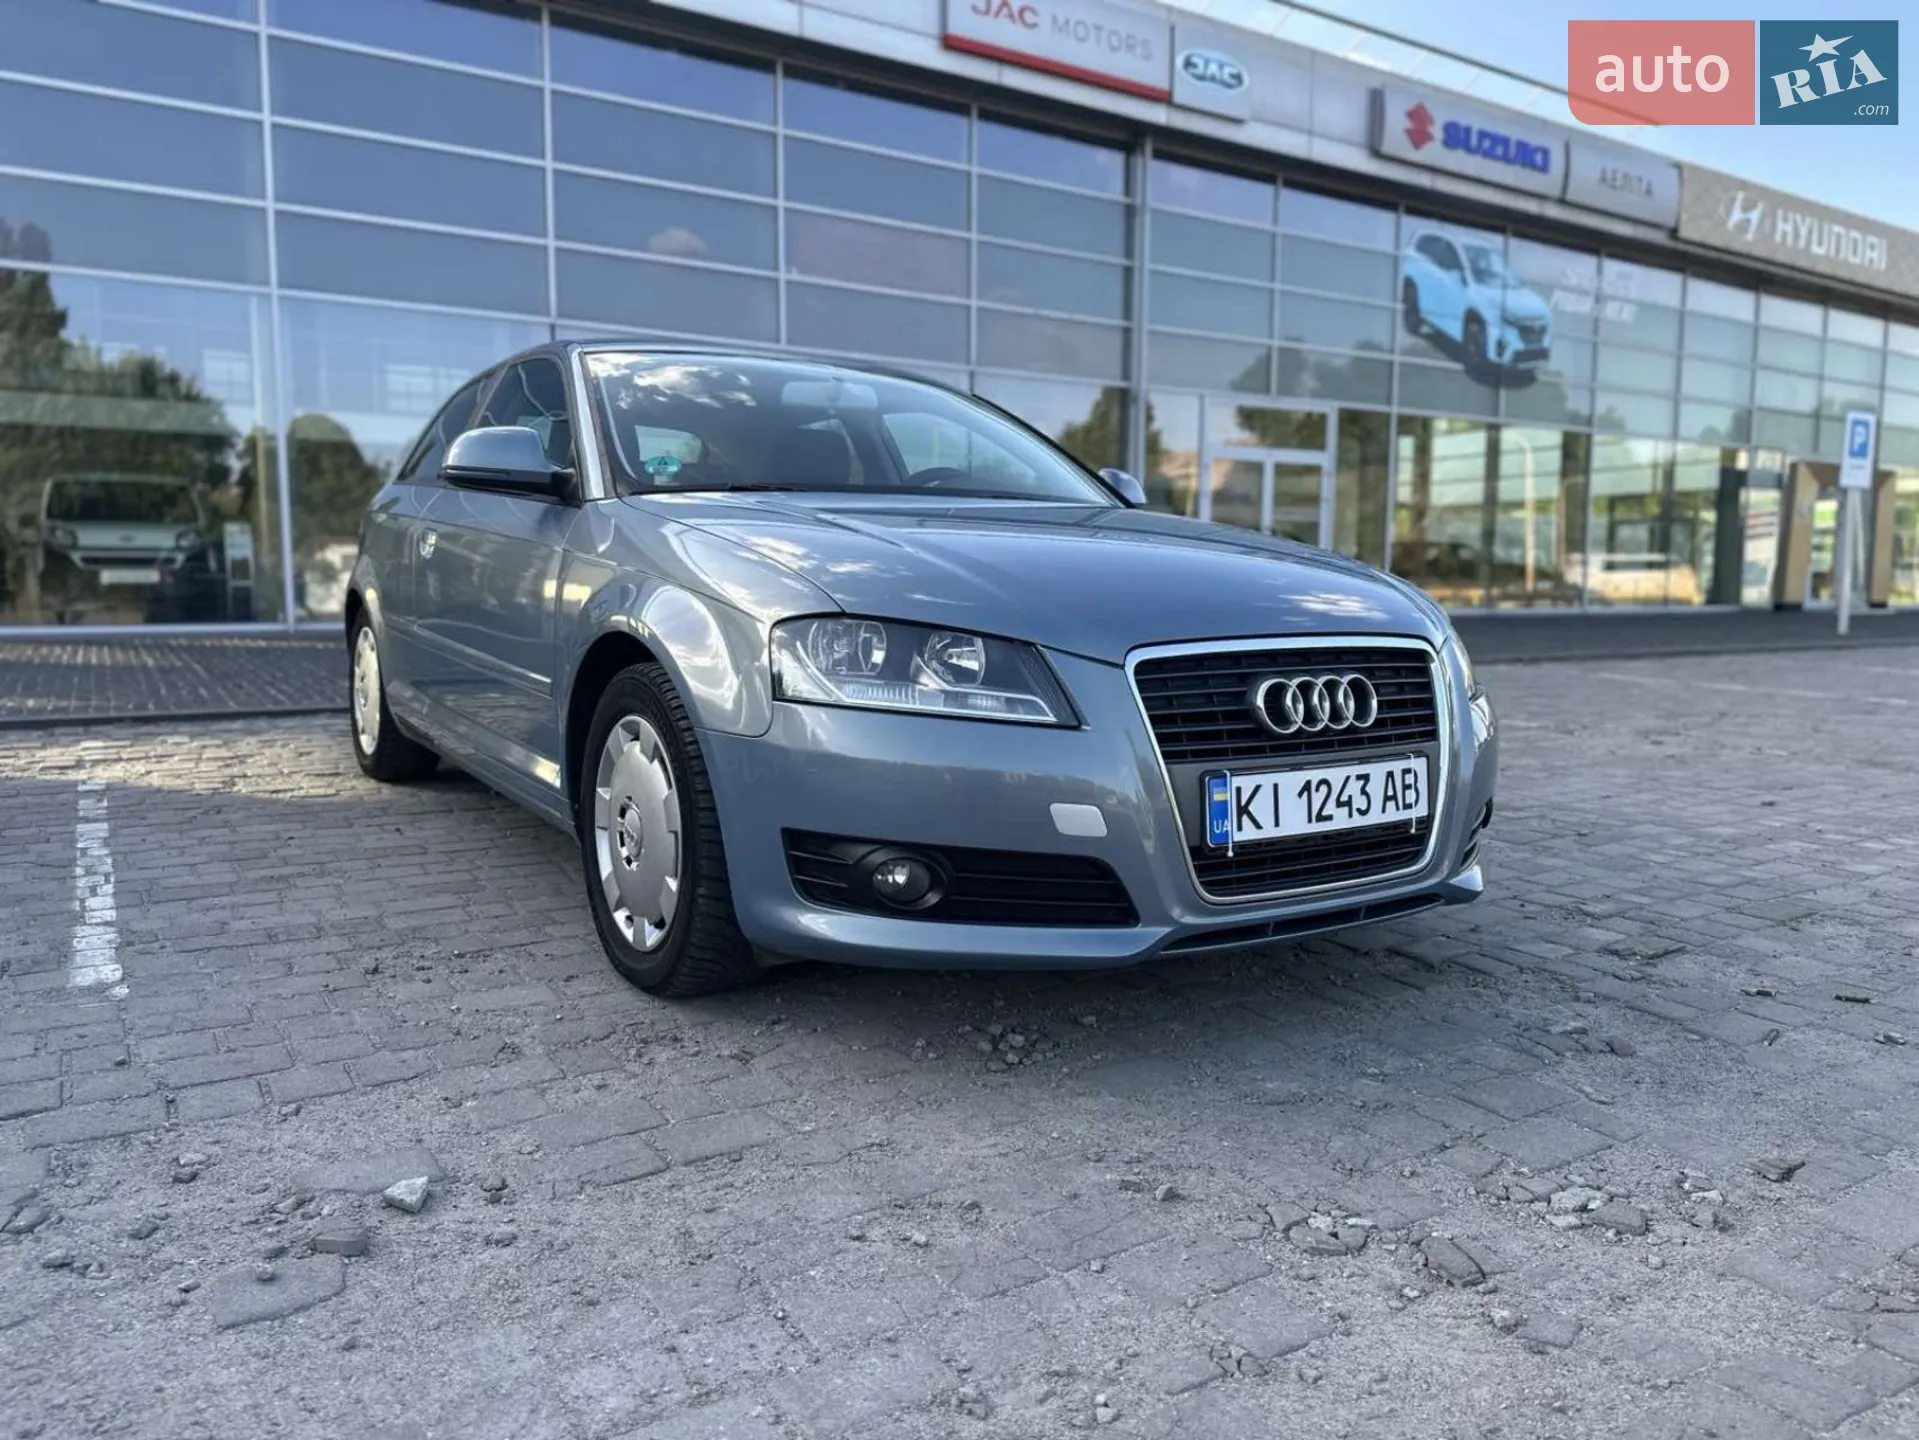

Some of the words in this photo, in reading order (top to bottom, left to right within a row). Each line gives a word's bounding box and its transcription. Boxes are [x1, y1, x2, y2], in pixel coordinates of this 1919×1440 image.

[970, 0, 1040, 29] JAC
[1050, 14, 1154, 61] MOTORS
[1182, 52, 1244, 89] JAC
[1441, 120, 1552, 174] SUZUKI
[1774, 208, 1889, 272] HYUNDAI
[1853, 425, 1867, 454] P
[1234, 782, 1280, 832] KI
[1297, 772, 1372, 824] 1243
[1381, 767, 1421, 814] AB
